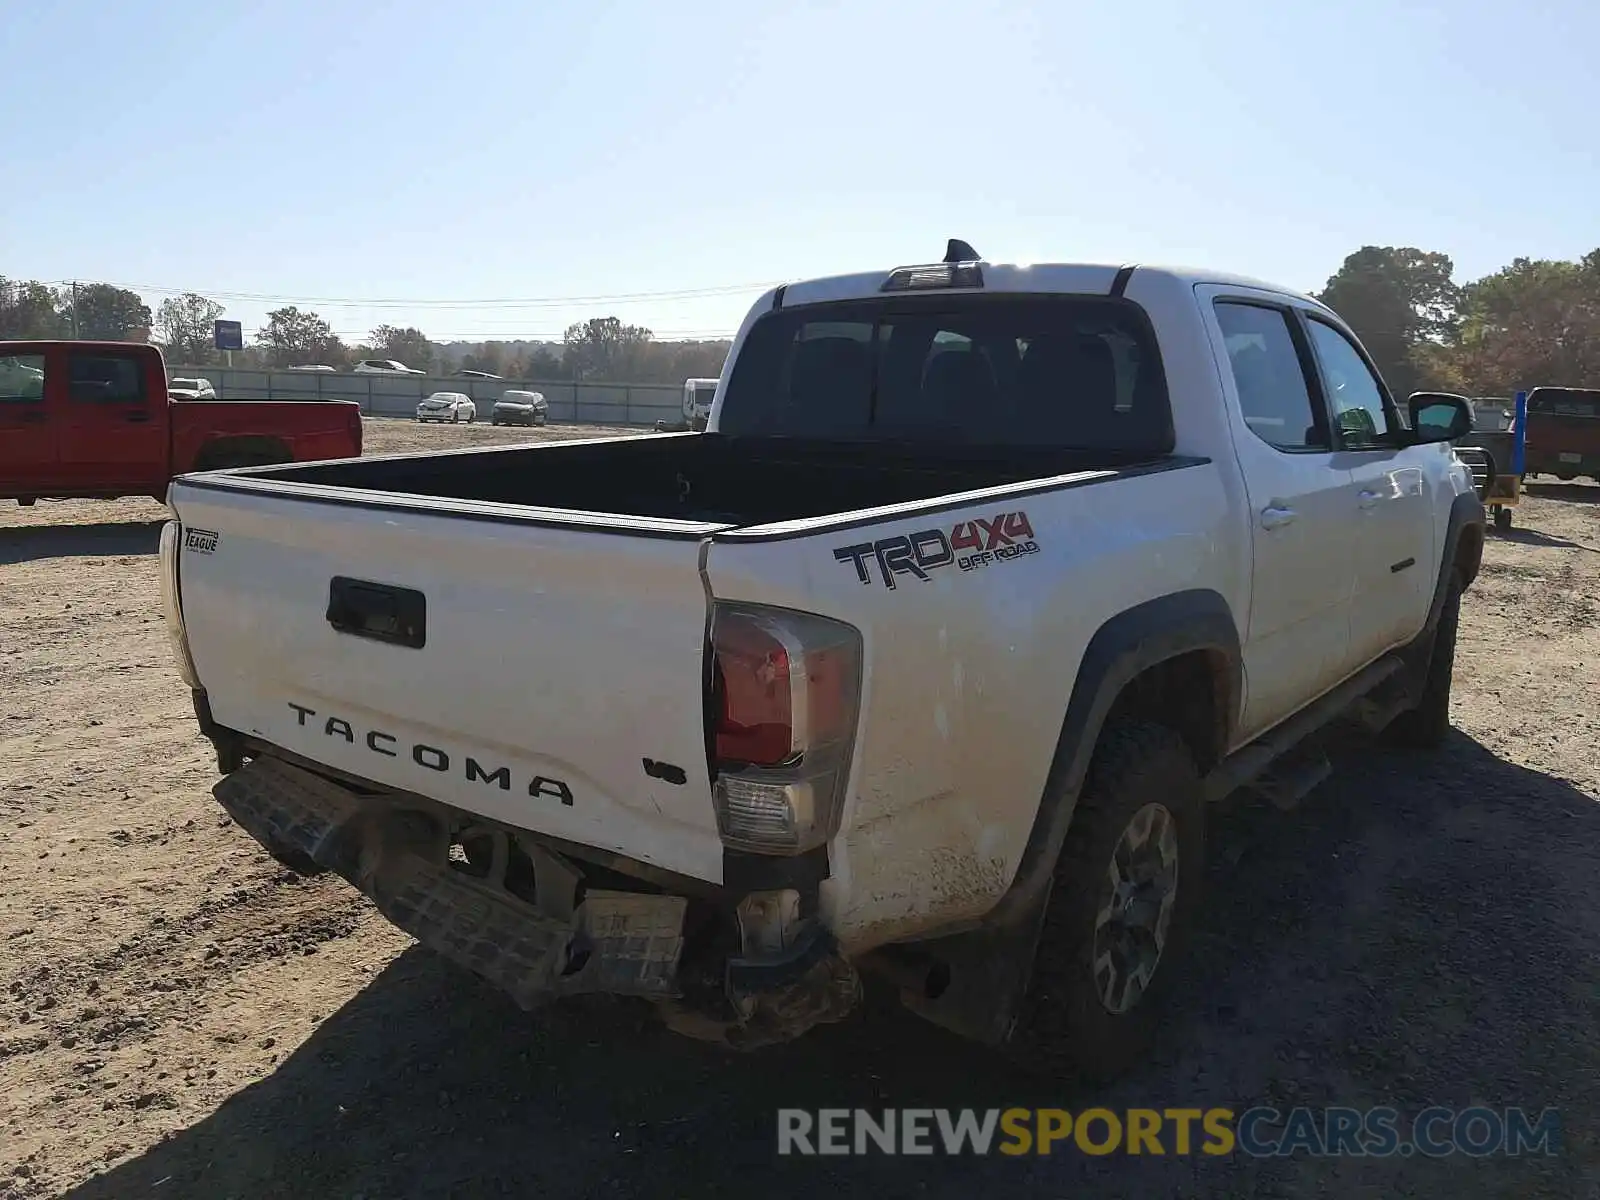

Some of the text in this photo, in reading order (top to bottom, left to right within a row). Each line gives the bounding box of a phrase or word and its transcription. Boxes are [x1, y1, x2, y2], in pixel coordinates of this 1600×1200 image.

[185, 527, 218, 551] TEAGUE
[958, 541, 1040, 571] OFF ROAD
[288, 702, 574, 807] TACOMA
